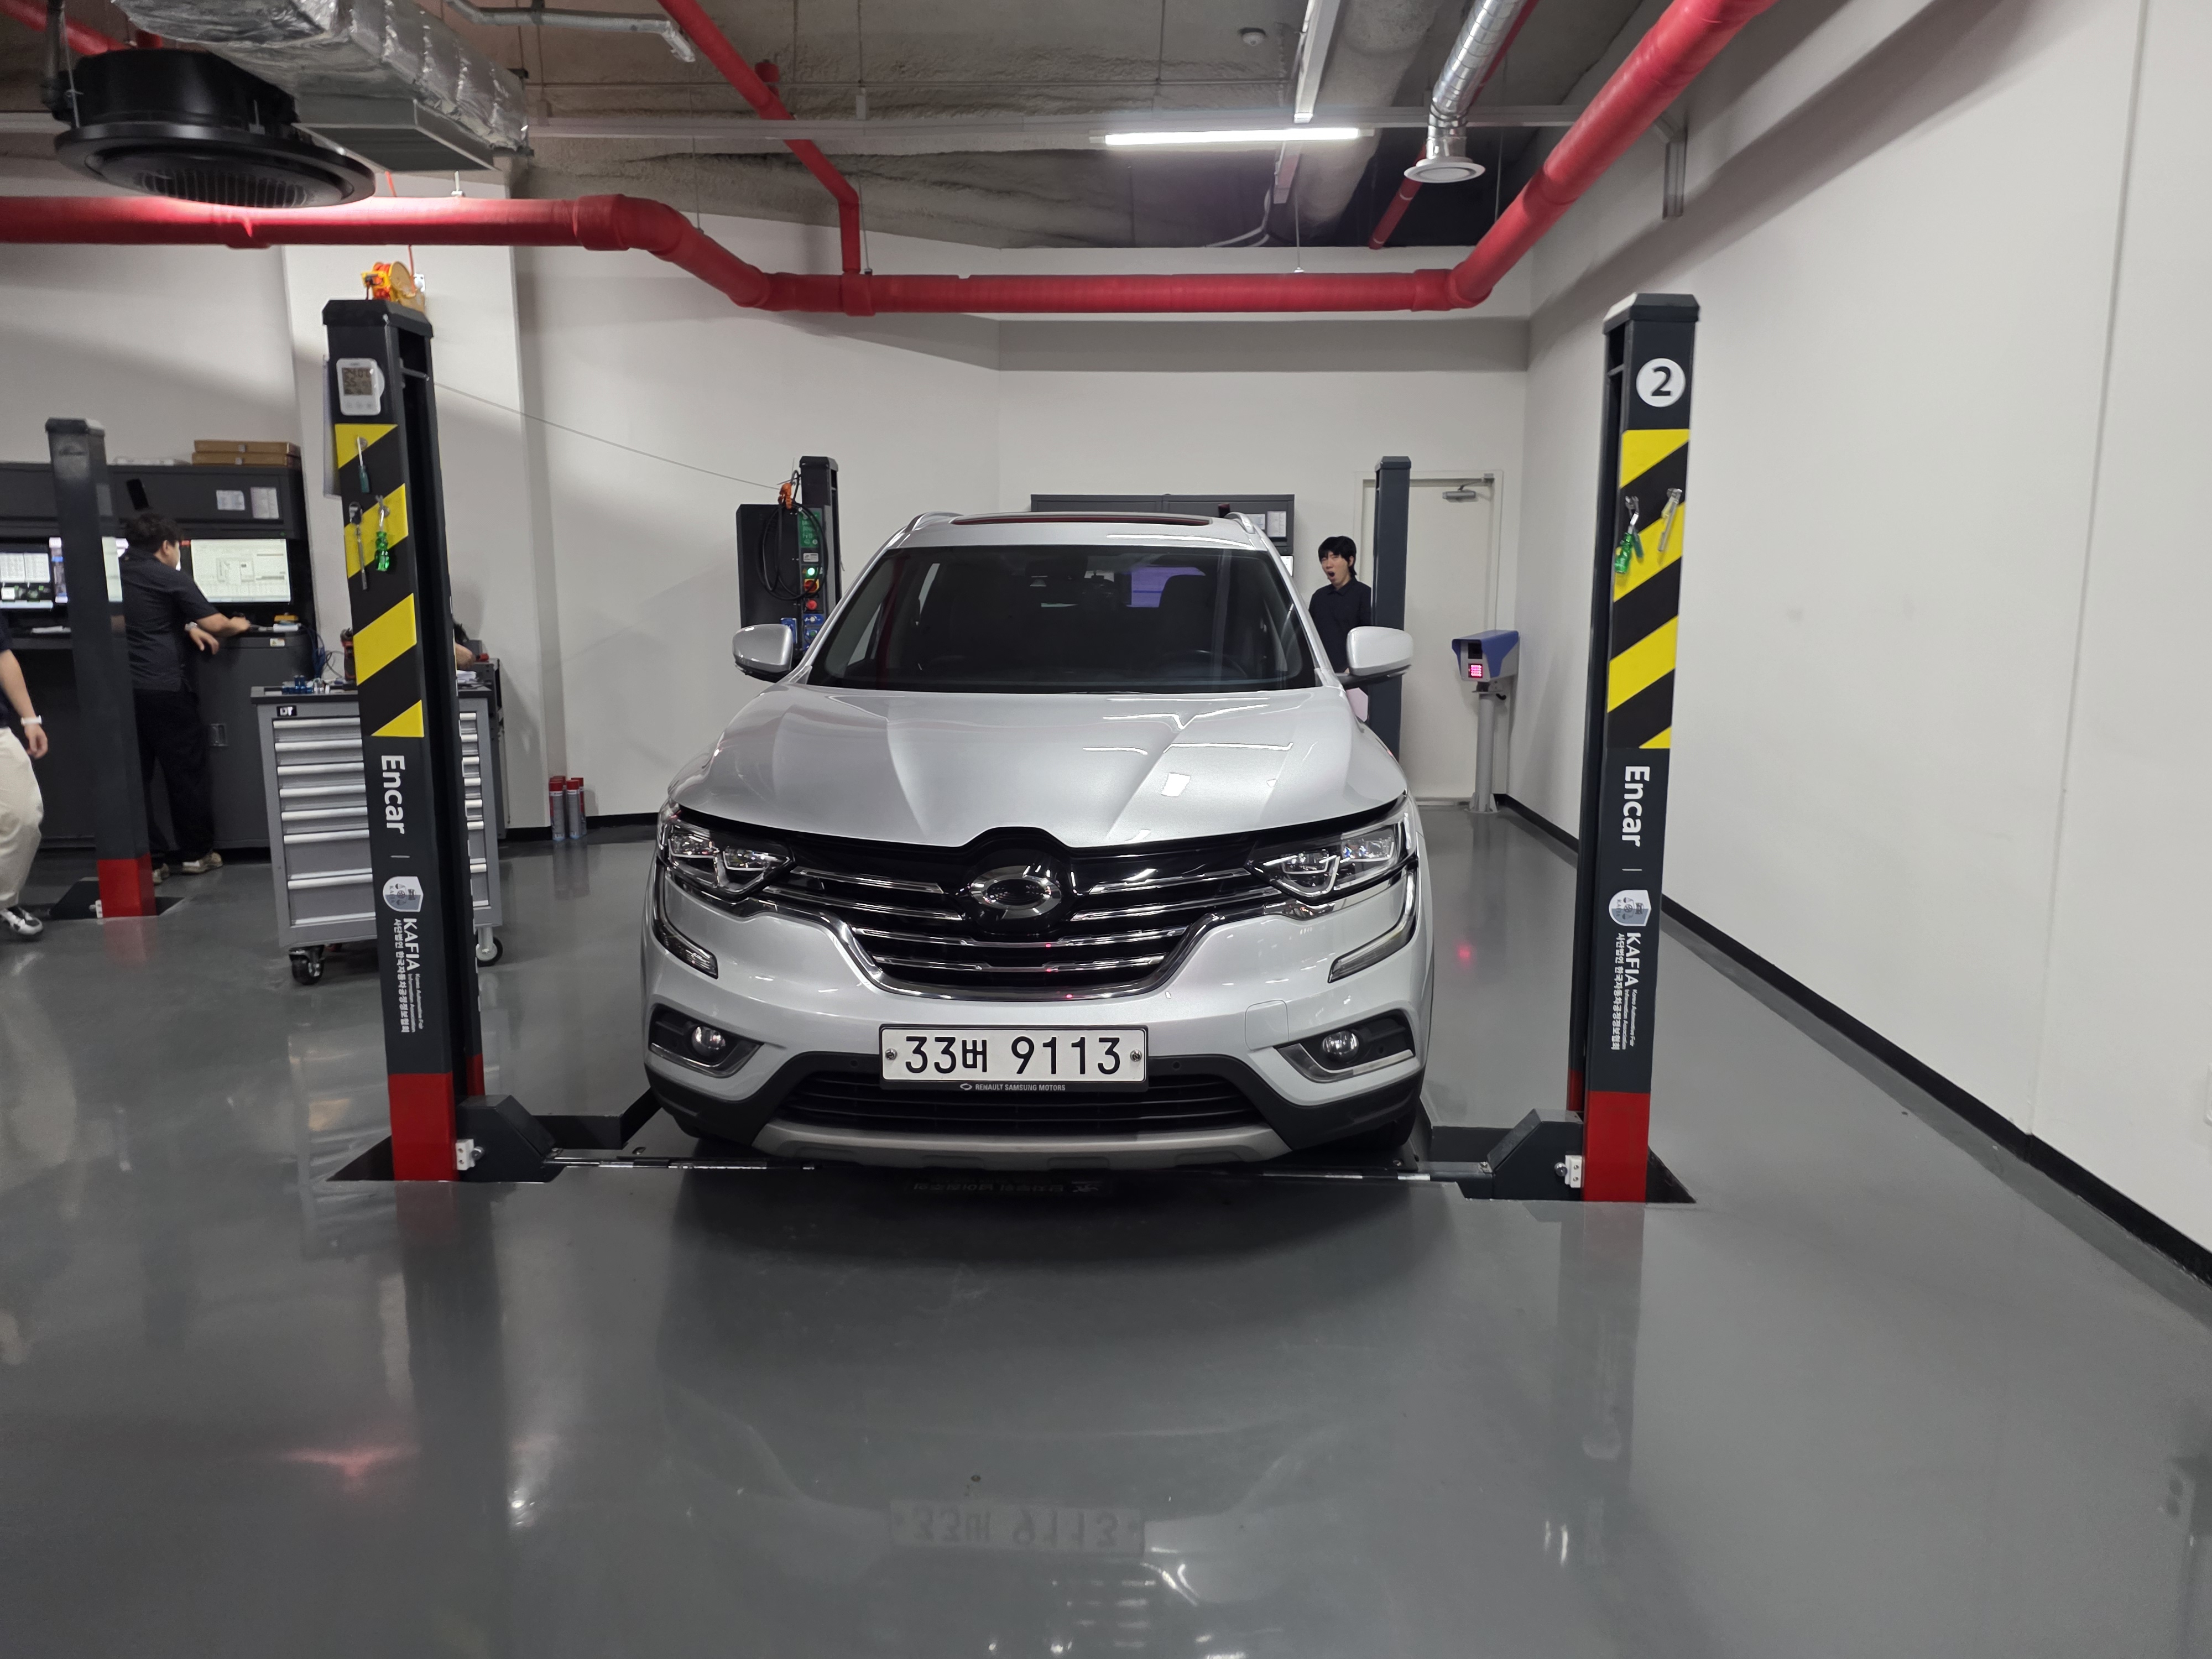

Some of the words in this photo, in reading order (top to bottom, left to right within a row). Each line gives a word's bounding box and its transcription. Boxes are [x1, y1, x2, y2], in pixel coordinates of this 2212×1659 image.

[1651, 366, 1671, 396] 2
[382, 755, 405, 834] Encar
[1622, 766, 1650, 847] Encar
[394, 919, 404, 949] 사단법인
[403, 918, 420, 971] KAFIA
[1615, 932, 1625, 964] 사단법인
[1624, 932, 1642, 987] KAFIA
[905, 1036, 987, 1074] 33버
[1011, 1036, 1120, 1074] 9113
